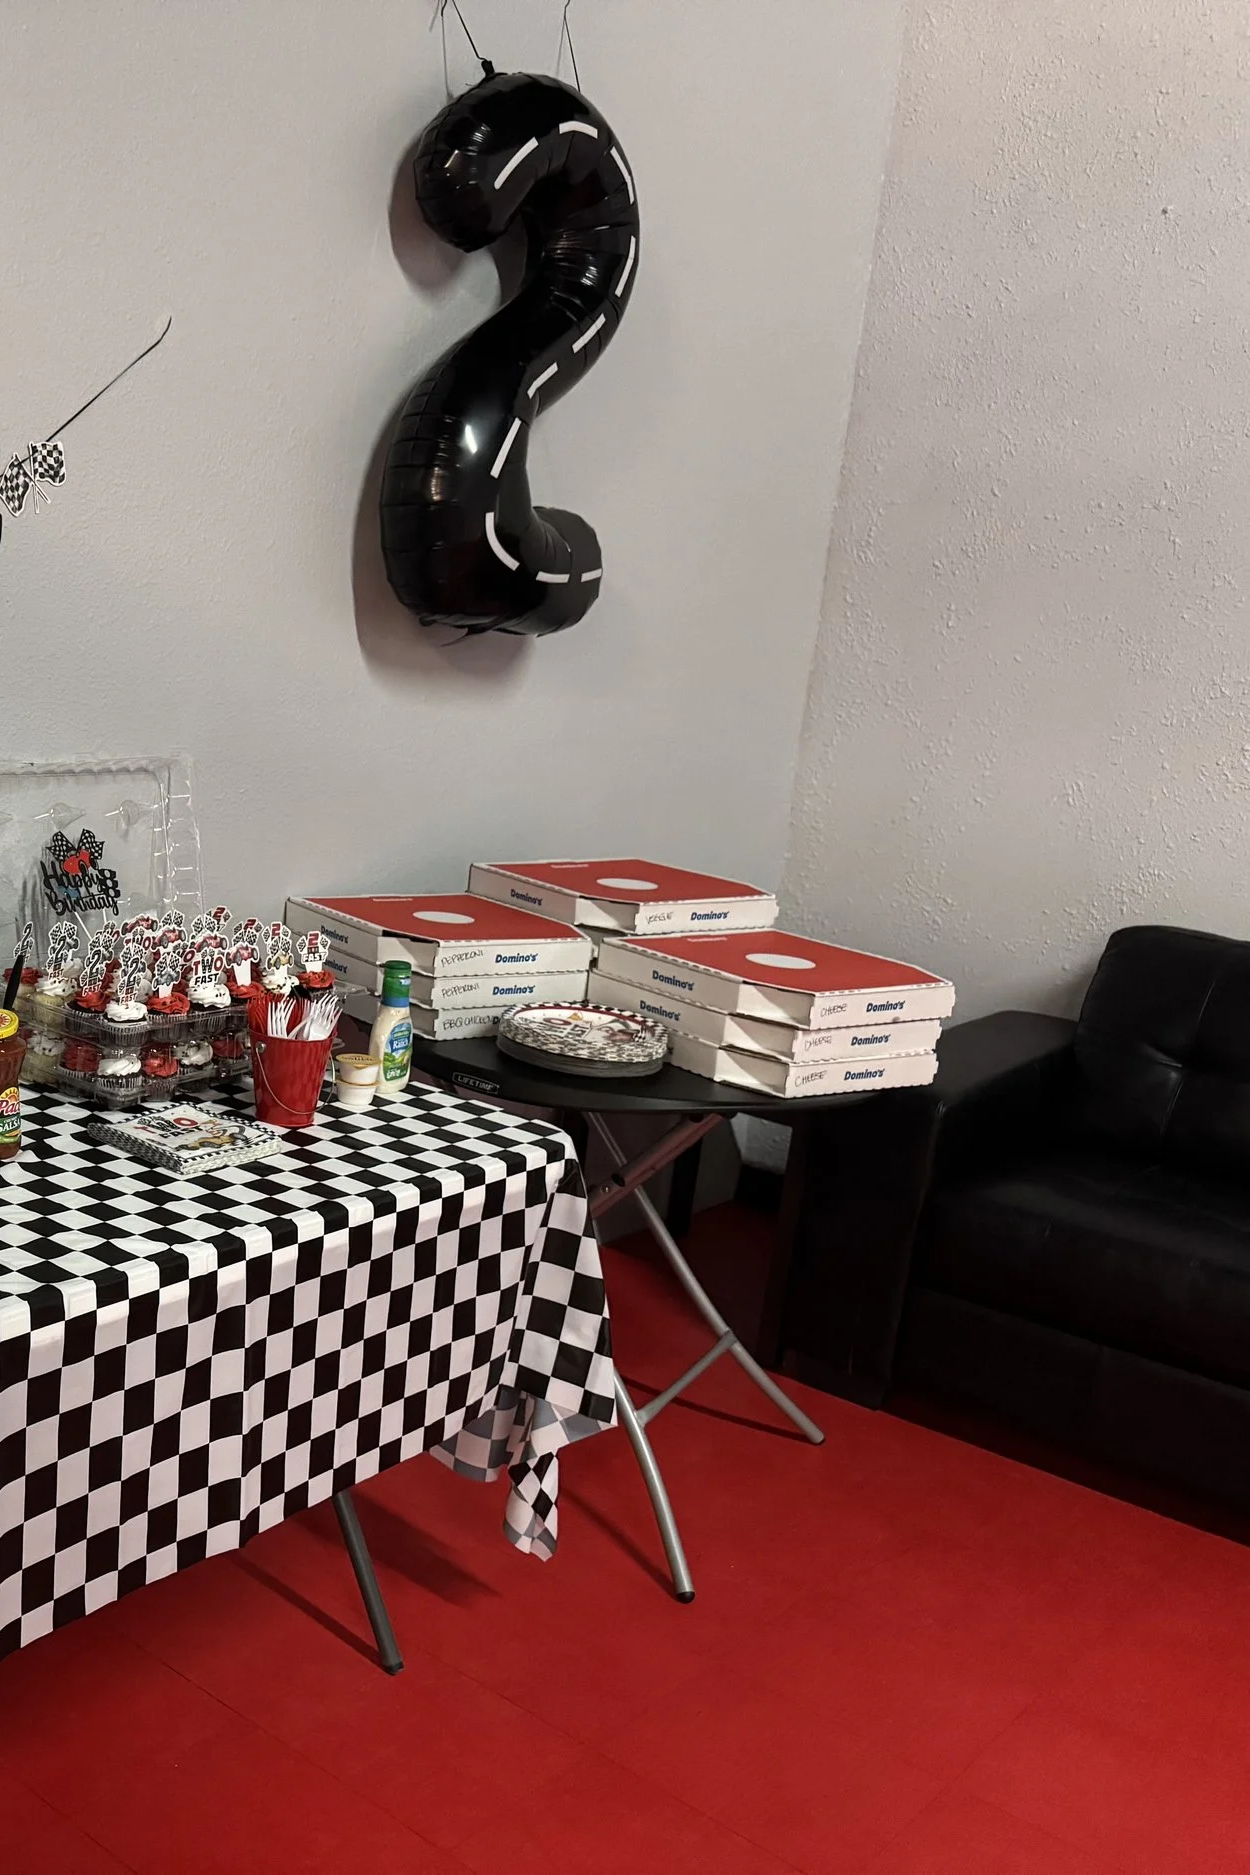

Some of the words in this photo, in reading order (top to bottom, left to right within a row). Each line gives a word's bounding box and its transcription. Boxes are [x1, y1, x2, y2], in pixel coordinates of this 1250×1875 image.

[510, 888, 543, 906] Domino's
[690, 910, 730, 921] Domino's
[271, 923, 281, 937] 2
[308, 932, 319, 948] 2
[54, 935, 67, 963] 2
[90, 949, 102, 978] 2
[303, 952, 327, 963] FAST
[441, 949, 484, 967] PEPPERONI
[495, 952, 539, 964] Domino's
[126, 957, 140, 985] 2
[193, 956, 224, 976] TWO
[194, 972, 220, 986] FAST
[652, 969, 695, 991] Domino's
[441, 982, 480, 999] PEPPERONI
[492, 984, 536, 996] Domino's
[639, 1000, 681, 1021] Domino's
[820, 1003, 848, 1017] CHEESE
[866, 1000, 906, 1013] Domino's
[804, 1036, 832, 1051] CHEESE
[850, 1034, 891, 1046] Domino's
[794, 1070, 828, 1087] CHEESE
[843, 1068, 886, 1081] Domino's
[457, 1074, 495, 1092] LIFETIME
